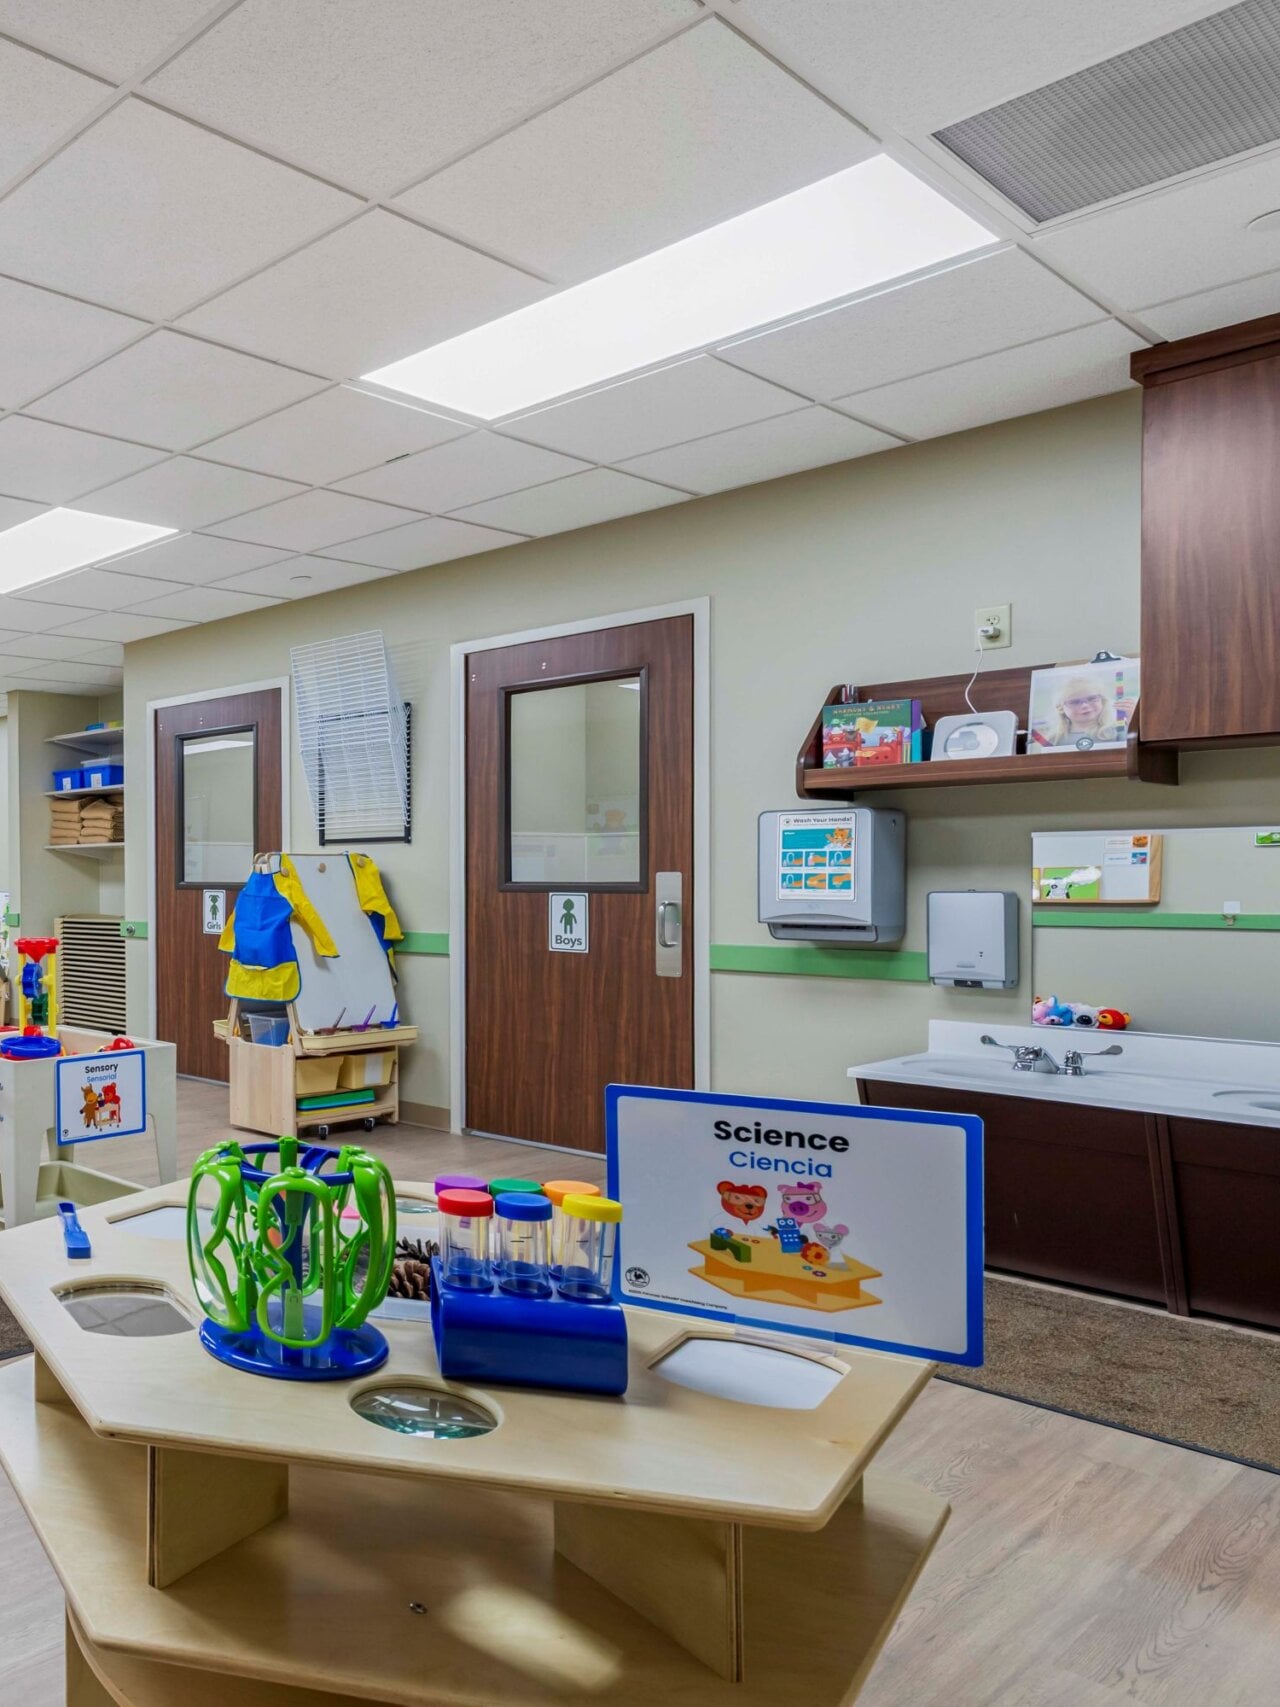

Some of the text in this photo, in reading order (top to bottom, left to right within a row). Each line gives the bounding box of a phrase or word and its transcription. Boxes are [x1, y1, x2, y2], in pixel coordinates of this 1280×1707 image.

[206, 921, 222, 930] Girls
[554, 934, 583, 949] Boys
[84, 1063, 119, 1074] Sensory
[86, 1072, 118, 1083] Sensorial
[713, 1119, 851, 1154] Science
[728, 1150, 834, 1179] Ciencia
